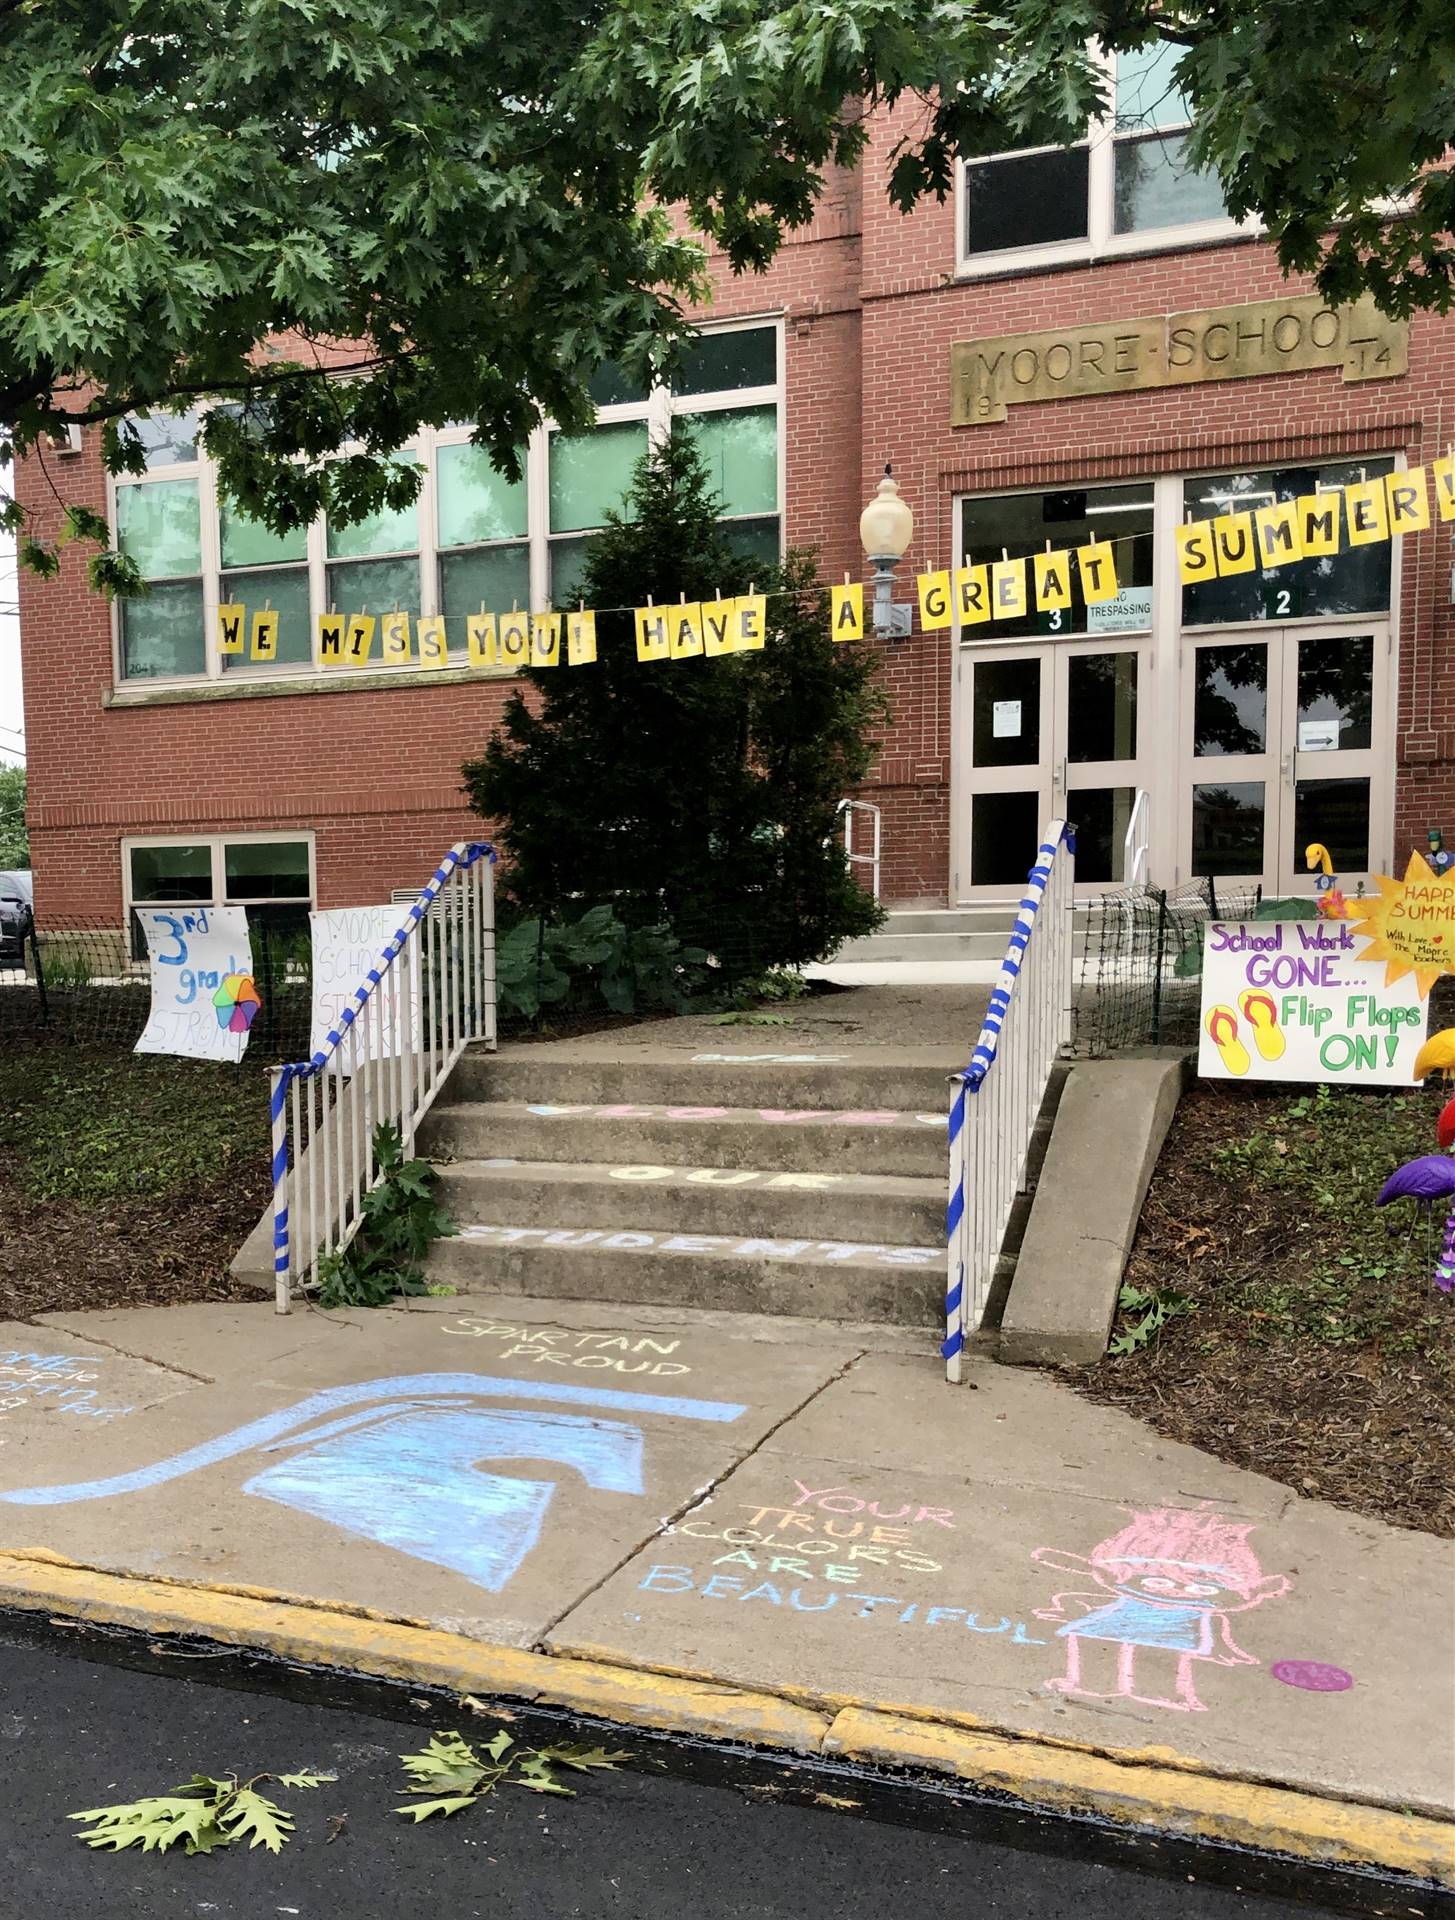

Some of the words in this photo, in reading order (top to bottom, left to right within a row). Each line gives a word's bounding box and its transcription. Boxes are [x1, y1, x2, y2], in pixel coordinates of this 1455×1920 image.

[978, 334, 1141, 388] MOORE
[221, 617, 271, 650] WE
[322, 625, 441, 658] MISS
[473, 626, 582, 656] YOU!
[642, 610, 758, 647] HAVE
[838, 600, 857, 629] A
[925, 557, 1103, 618] GREAT
[1049, 608, 1062, 630] 3
[1090, 602, 1151, 618] TRESPASSING
[1276, 590, 1291, 615] 2
[1210, 923, 1283, 952] School
[1296, 923, 1355, 951] Work
[144, 1008, 239, 1049] STRON
[1281, 995, 1333, 1037] Flip
[1347, 995, 1421, 1034] Flops
[1319, 1034, 1400, 1072] ON!
[595, 1104, 900, 1125] LOVE
[608, 1165, 843, 1189] OUR
[458, 1225, 943, 1264] STUDENTS
[441, 1318, 682, 1355] SPARTAN
[499, 1344, 692, 1375] PROUD
[793, 1479, 958, 1529] YOUR
[738, 1503, 913, 1547] TRUE
[678, 1521, 943, 1574] COLORS
[712, 1549, 863, 1585] ARE
[637, 1564, 1051, 1646] BEAUTIFUL
